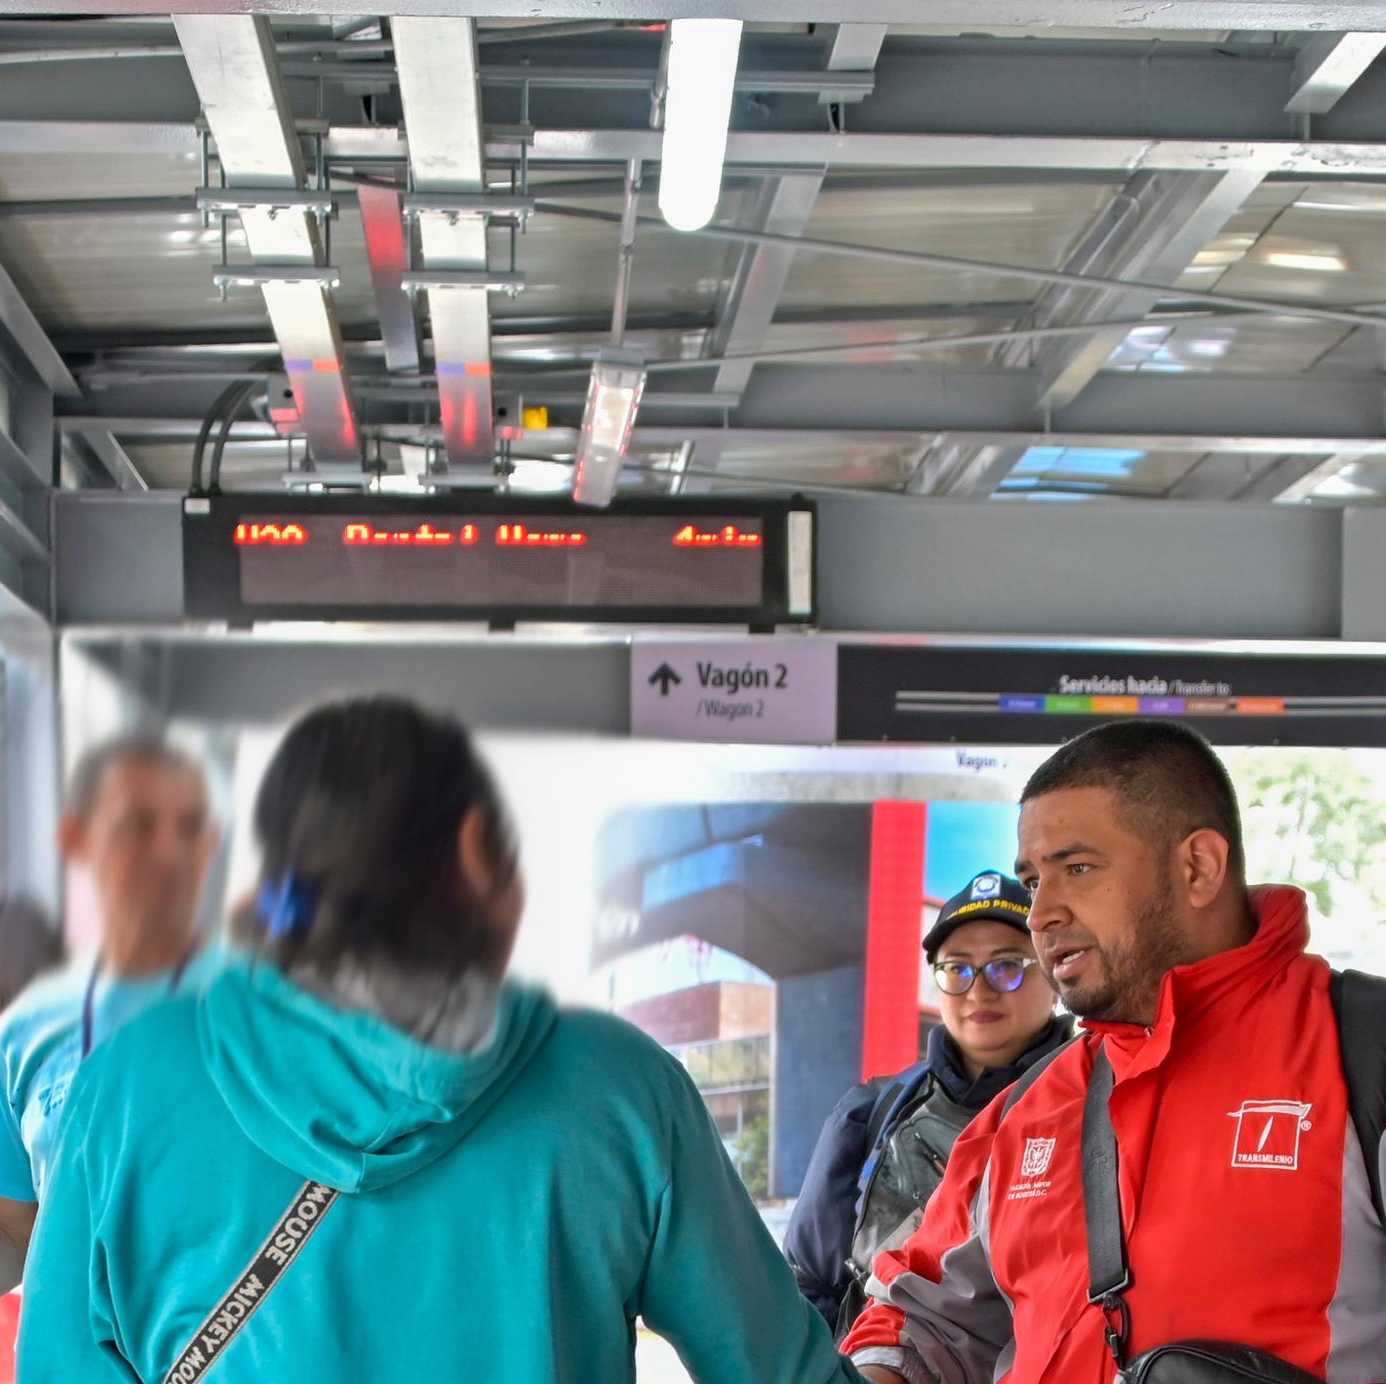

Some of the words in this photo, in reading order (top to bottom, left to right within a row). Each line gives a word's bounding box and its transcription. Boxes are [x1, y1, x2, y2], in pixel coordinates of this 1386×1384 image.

[697, 660, 769, 694] Vagón
[774, 663, 788, 688] 2
[1127, 675, 1169, 695] hacia
[756, 700, 765, 718] 2
[993, 899, 1030, 917] PRIVAD
[1237, 1153, 1293, 1165] TRANSMILENIO
[265, 1182, 332, 1267] MOUSE
[206, 1273, 265, 1355] MICKEY
